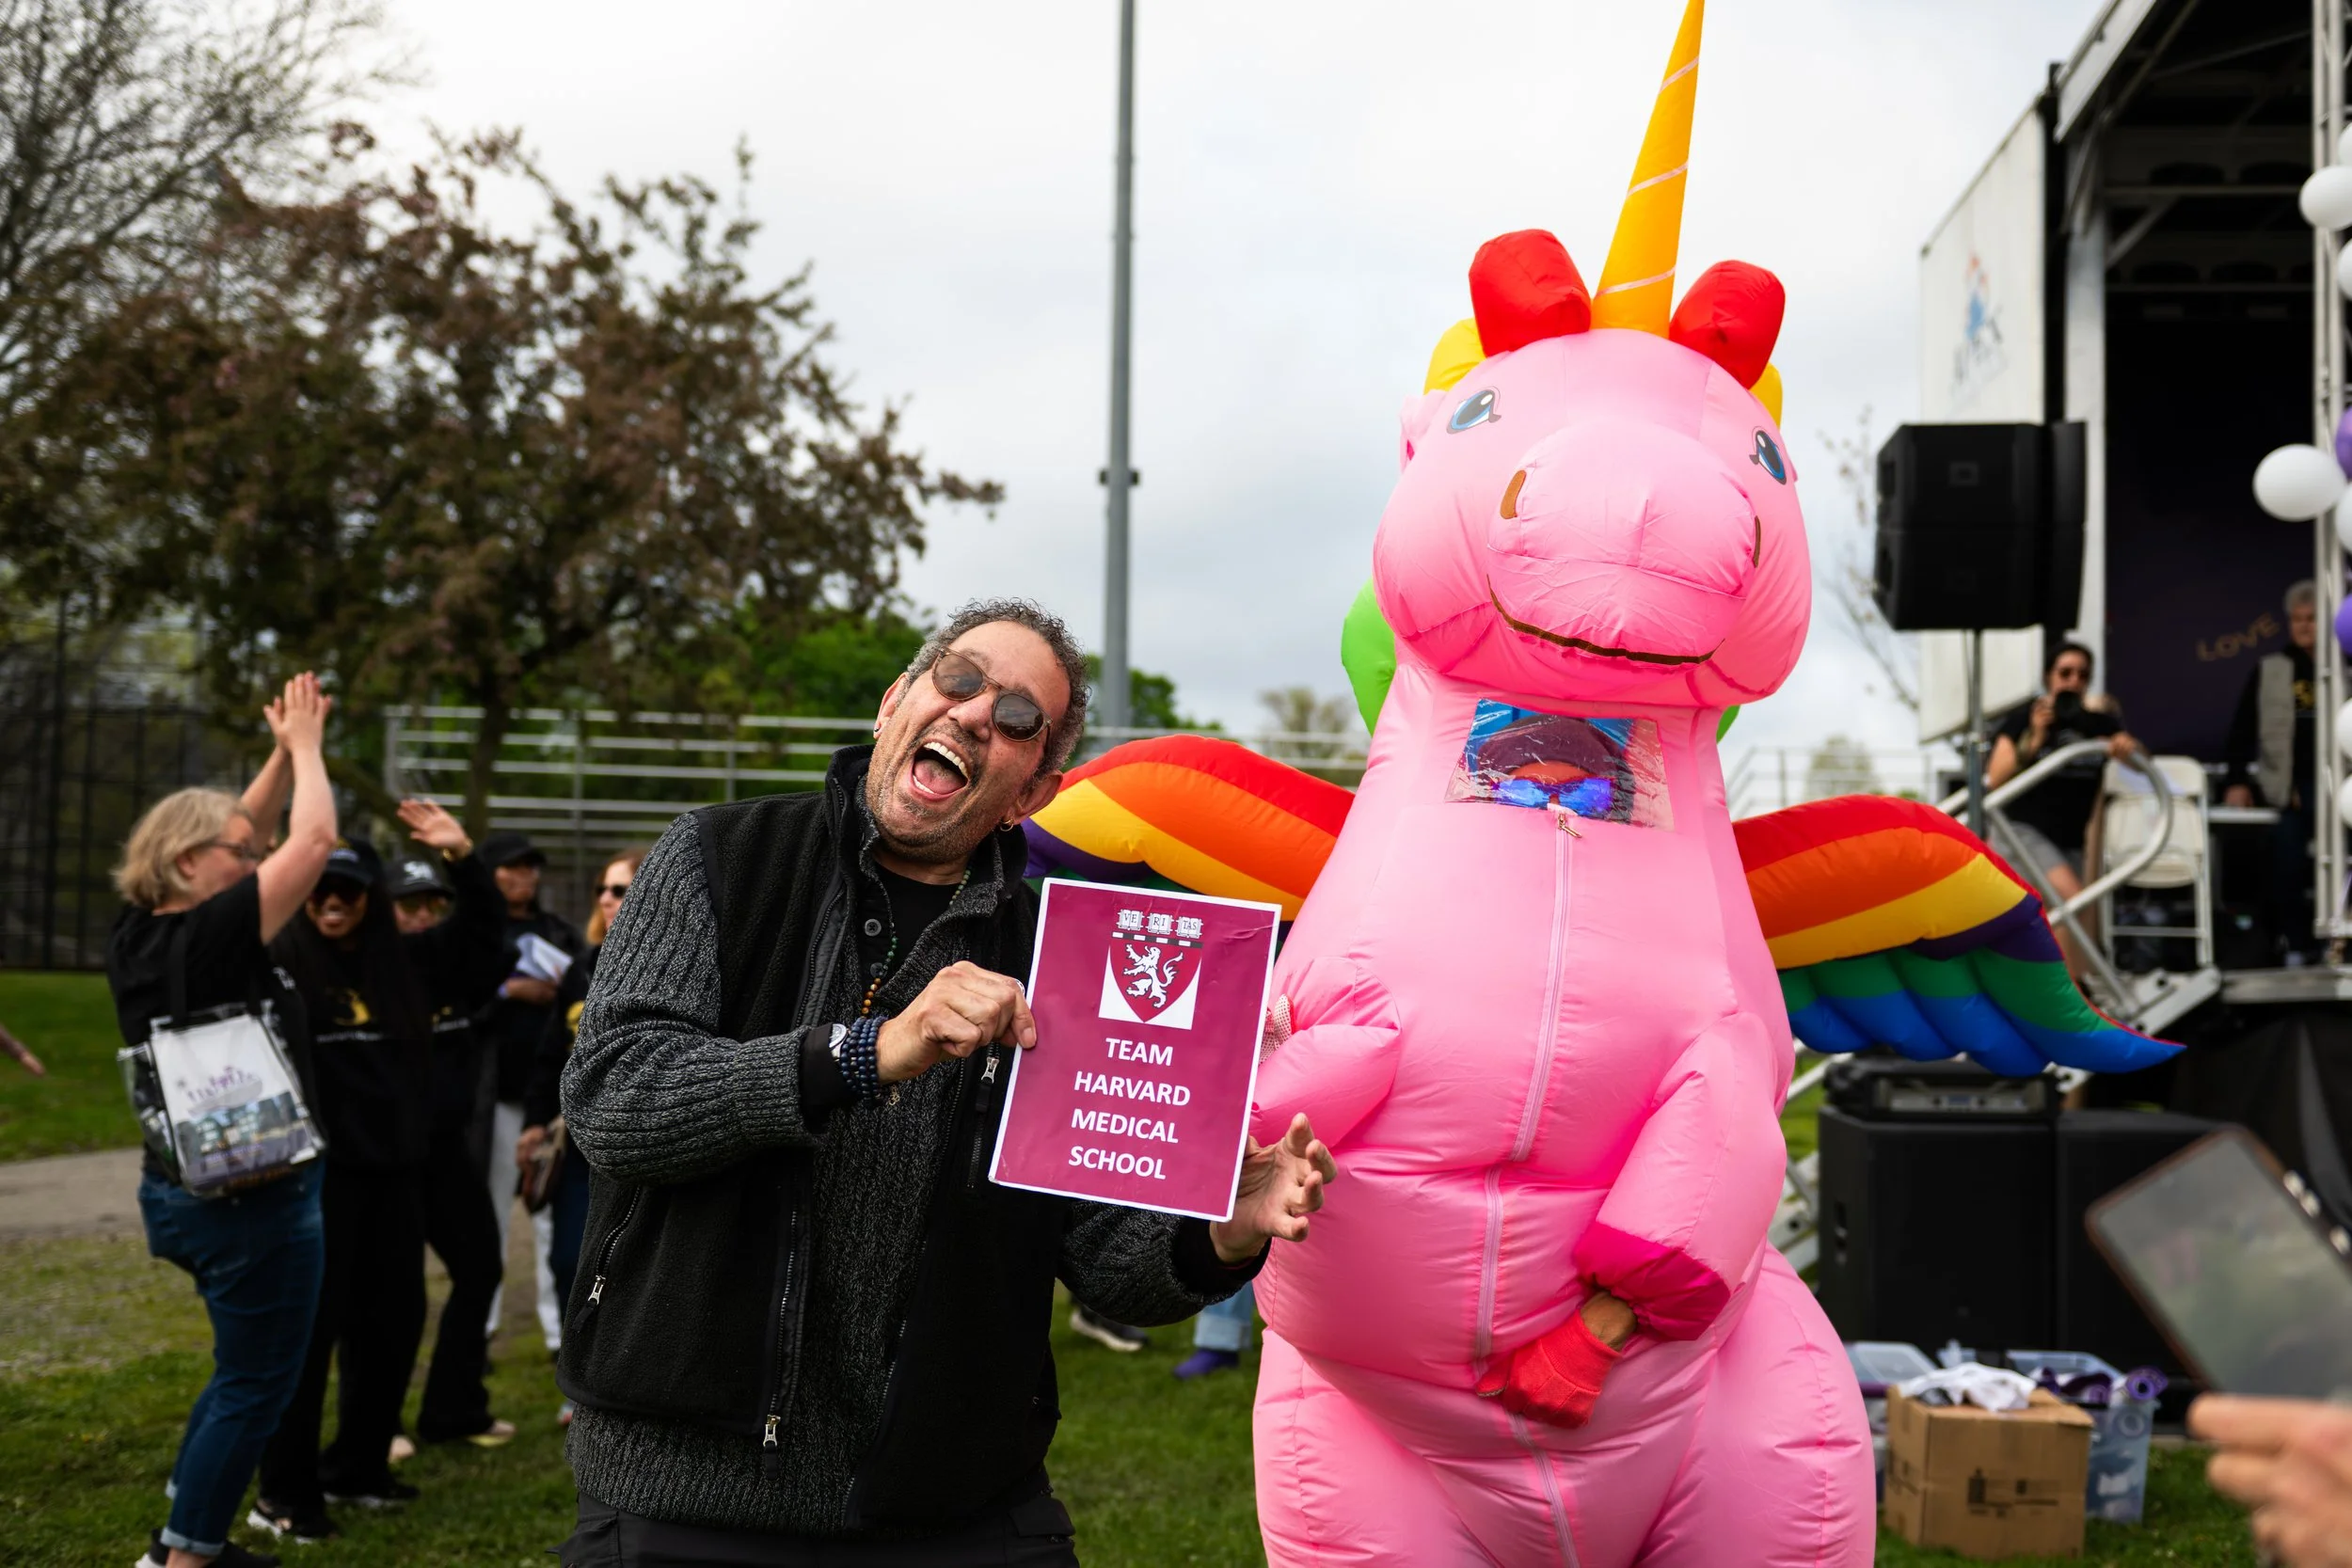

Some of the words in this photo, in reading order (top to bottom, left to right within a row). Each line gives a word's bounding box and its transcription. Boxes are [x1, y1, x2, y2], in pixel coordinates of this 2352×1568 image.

[2196, 612, 2280, 662] LOVE
[1124, 912, 1137, 924] VE
[1152, 916, 1166, 927] RI
[1183, 920, 1197, 930] TAS
[1105, 1037, 1173, 1066] TEAM
[1073, 1070, 1191, 1106] HARVARD
[1071, 1108, 1179, 1144] MEDICAL
[1068, 1146, 1167, 1180] SCHOOL
